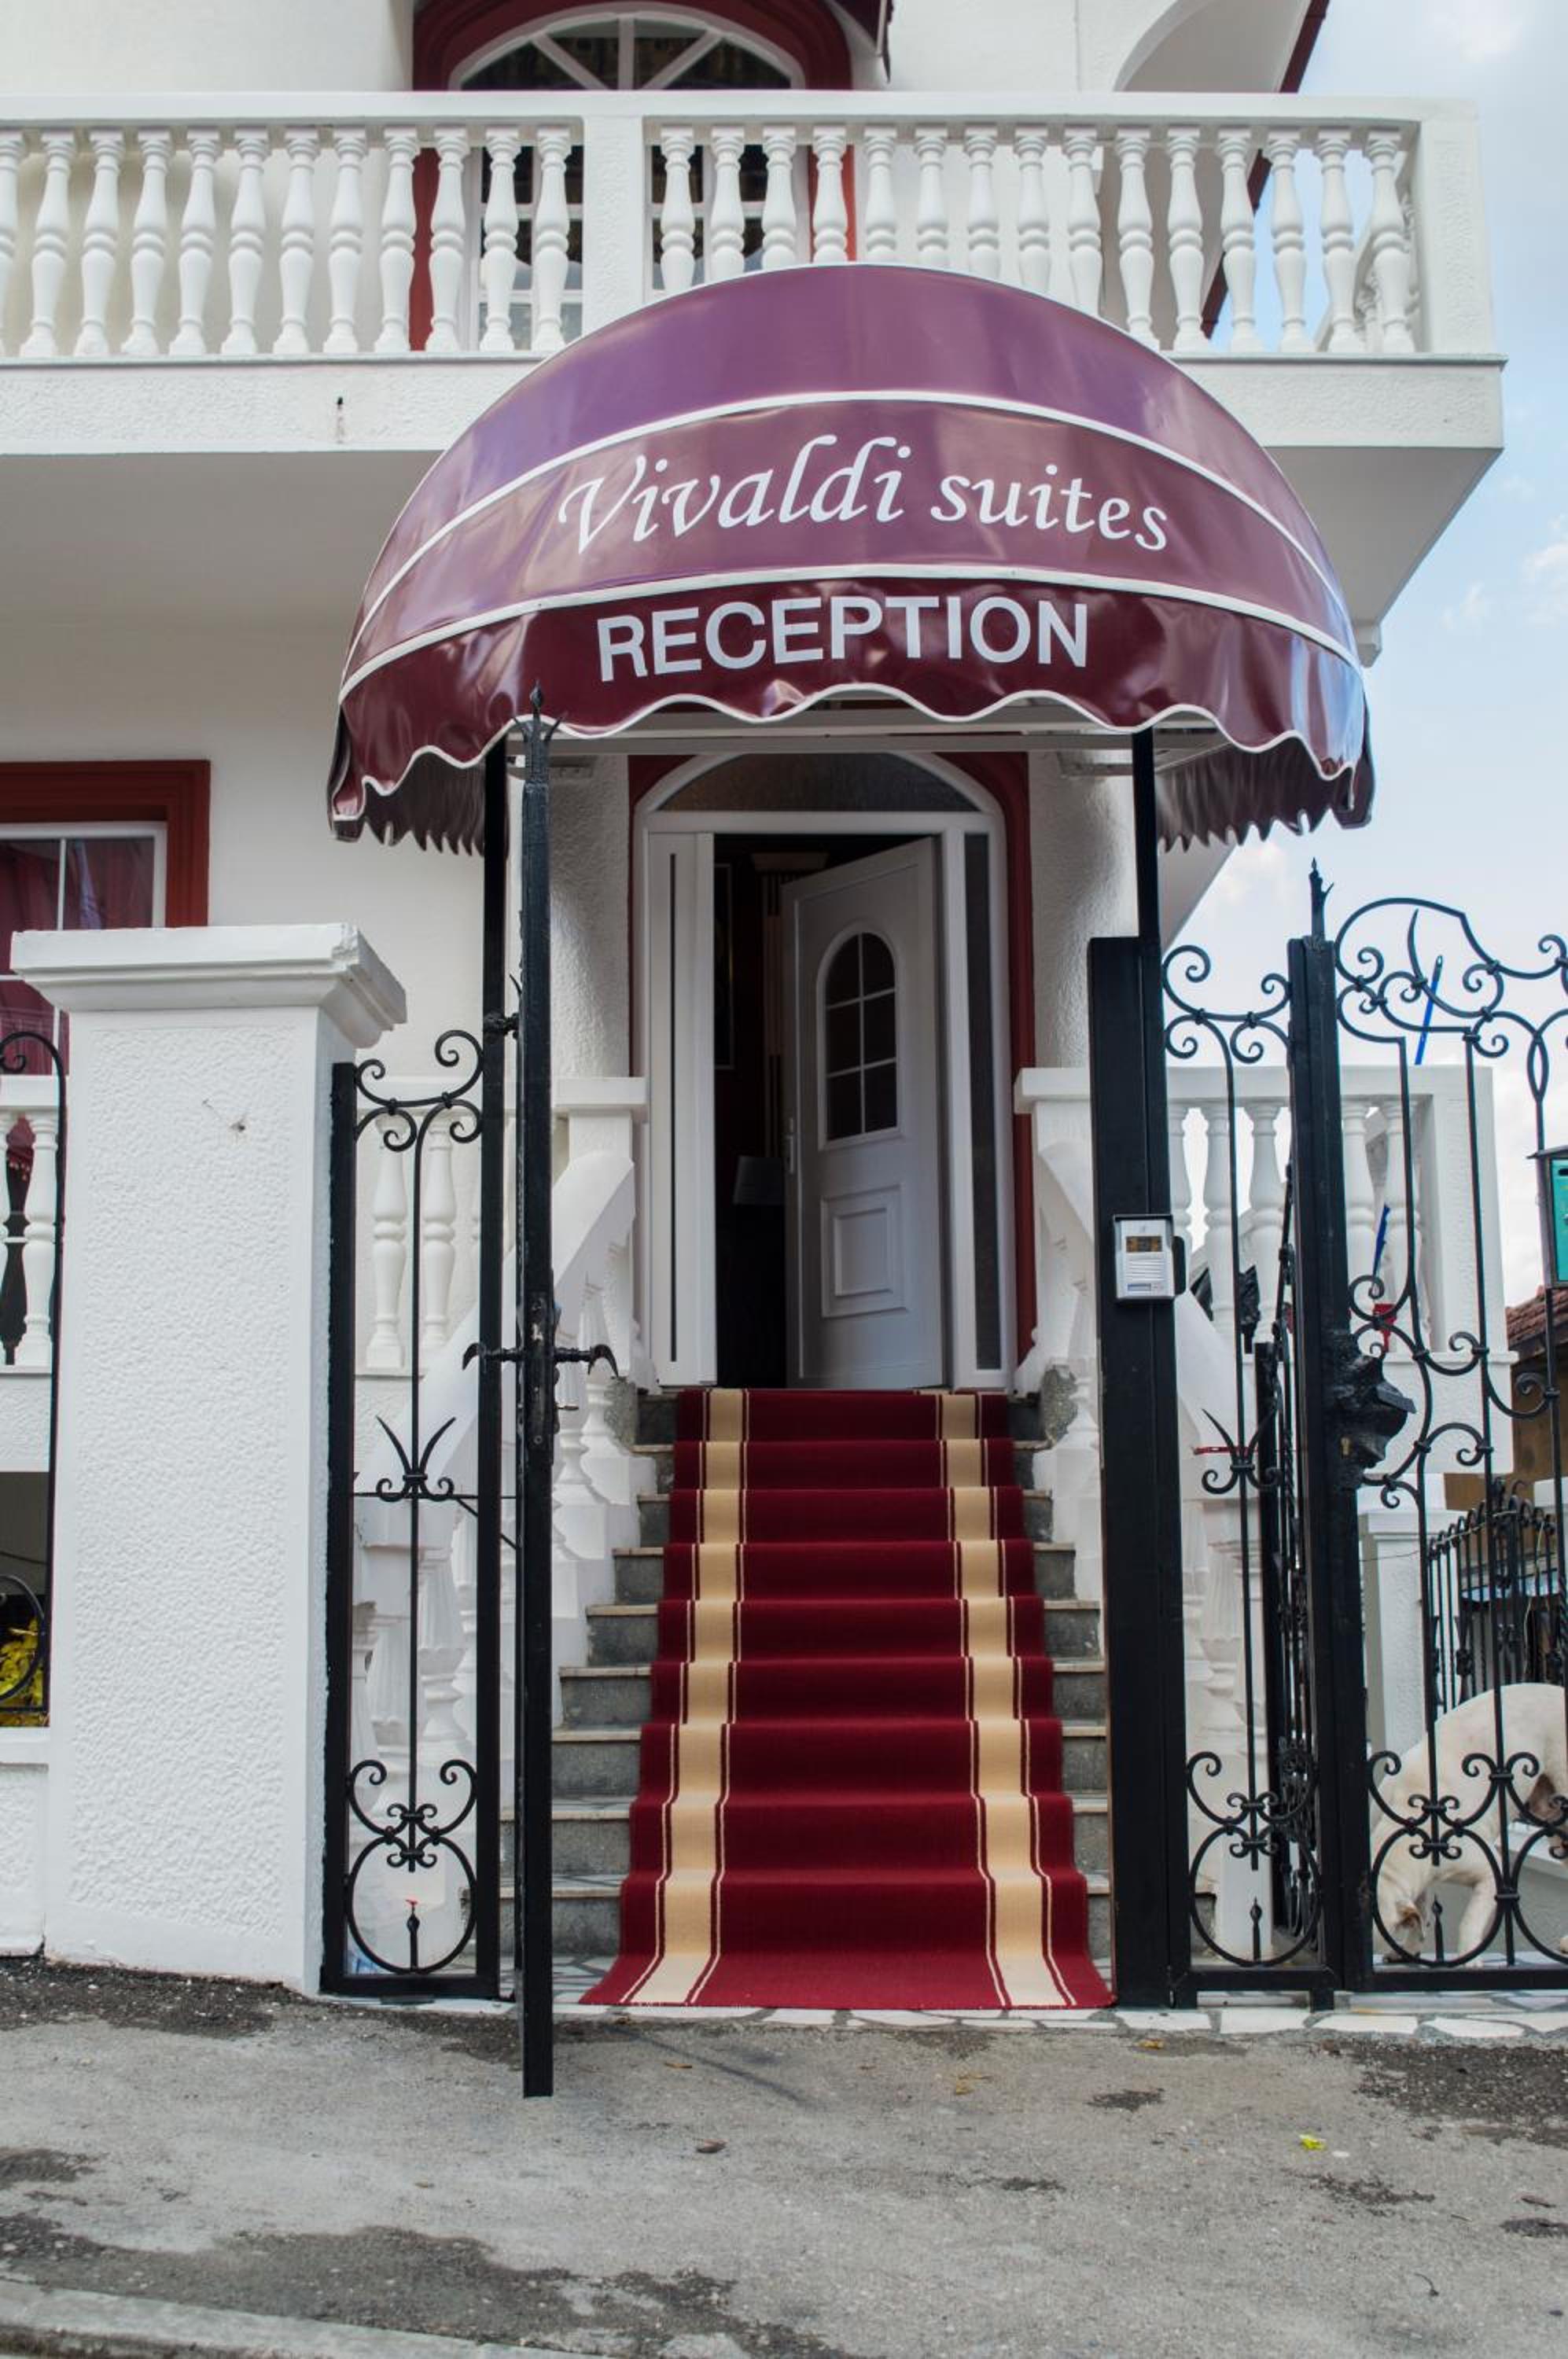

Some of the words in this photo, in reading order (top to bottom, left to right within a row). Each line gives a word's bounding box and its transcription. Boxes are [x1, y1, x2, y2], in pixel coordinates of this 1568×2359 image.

[558, 433, 911, 555] Vivaldi
[930, 465, 1167, 550] suites
[597, 595, 1088, 682] RECEPTION
